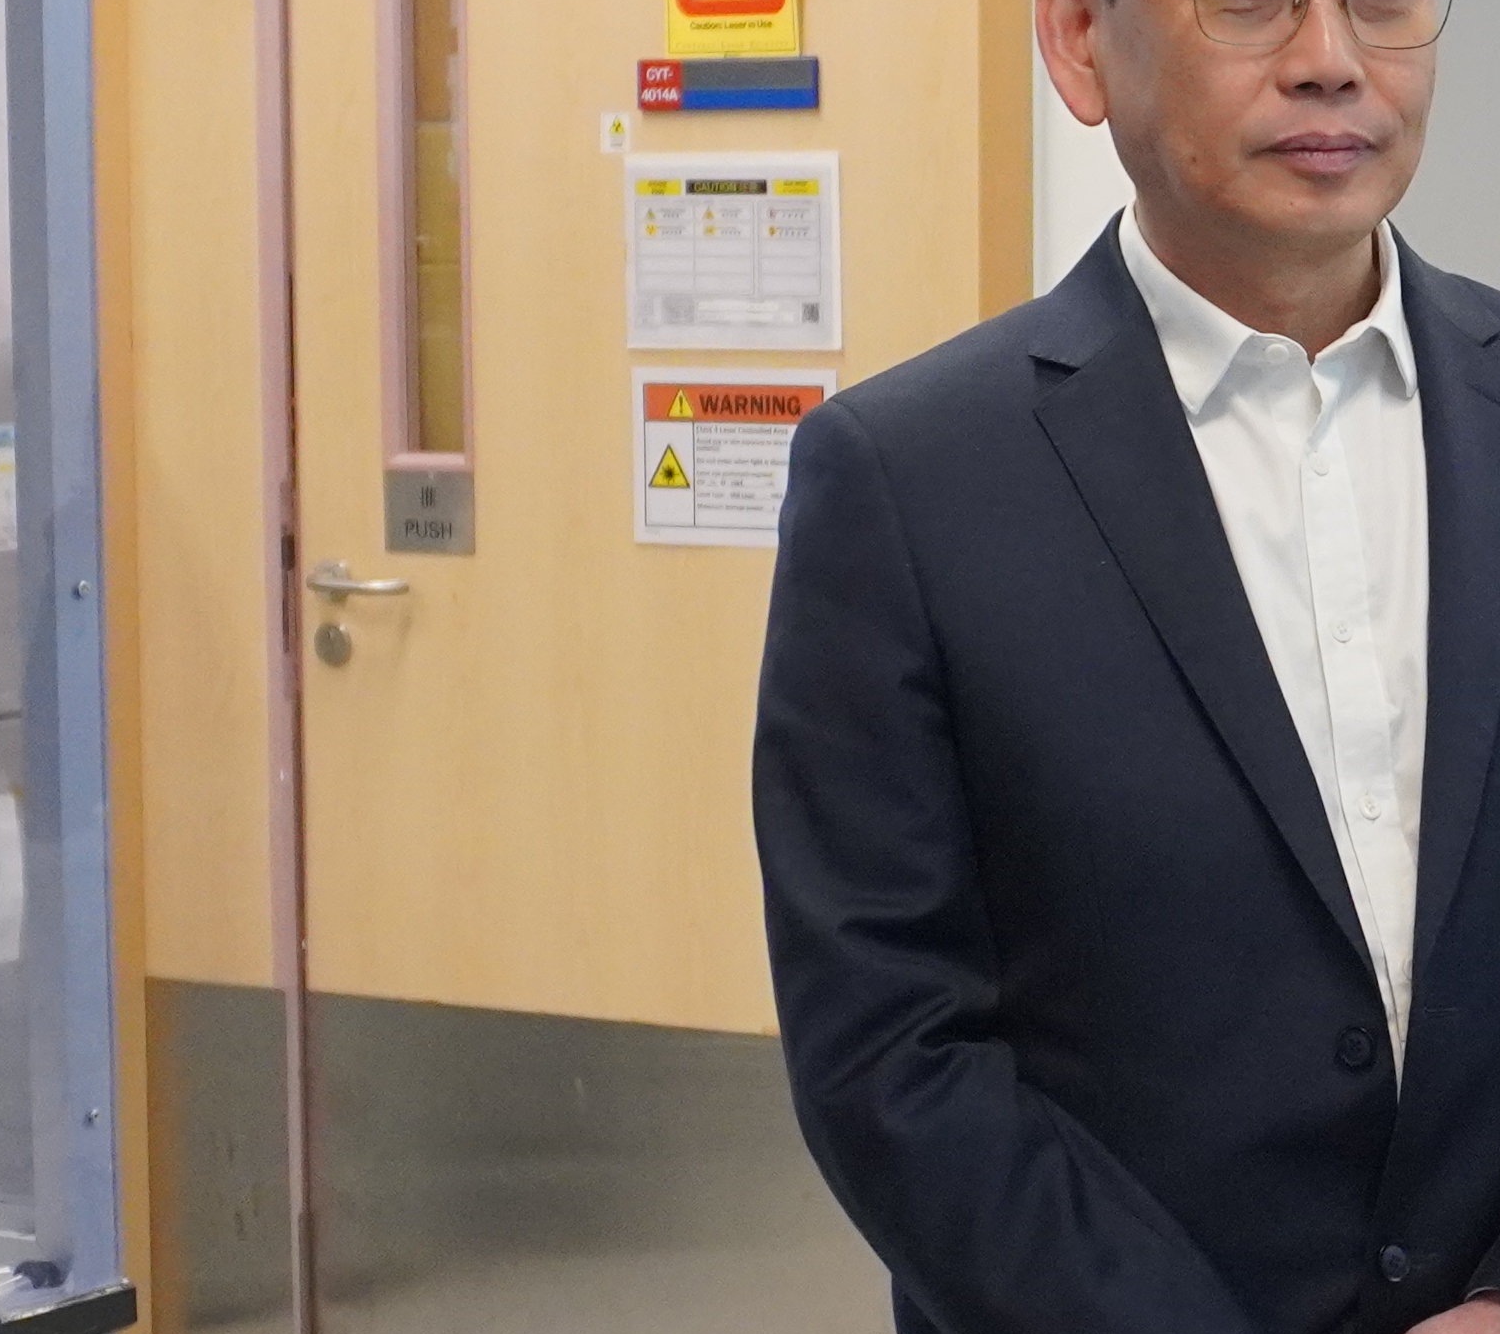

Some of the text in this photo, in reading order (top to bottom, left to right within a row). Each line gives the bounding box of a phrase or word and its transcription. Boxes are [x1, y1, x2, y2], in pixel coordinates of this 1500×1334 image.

[757, 19, 773, 29] Use
[645, 66, 673, 82] CYT-
[641, 87, 679, 103] 4014A
[694, 181, 738, 193] CAUTION
[698, 393, 802, 417] WARNING
[404, 519, 452, 540] PUSH
